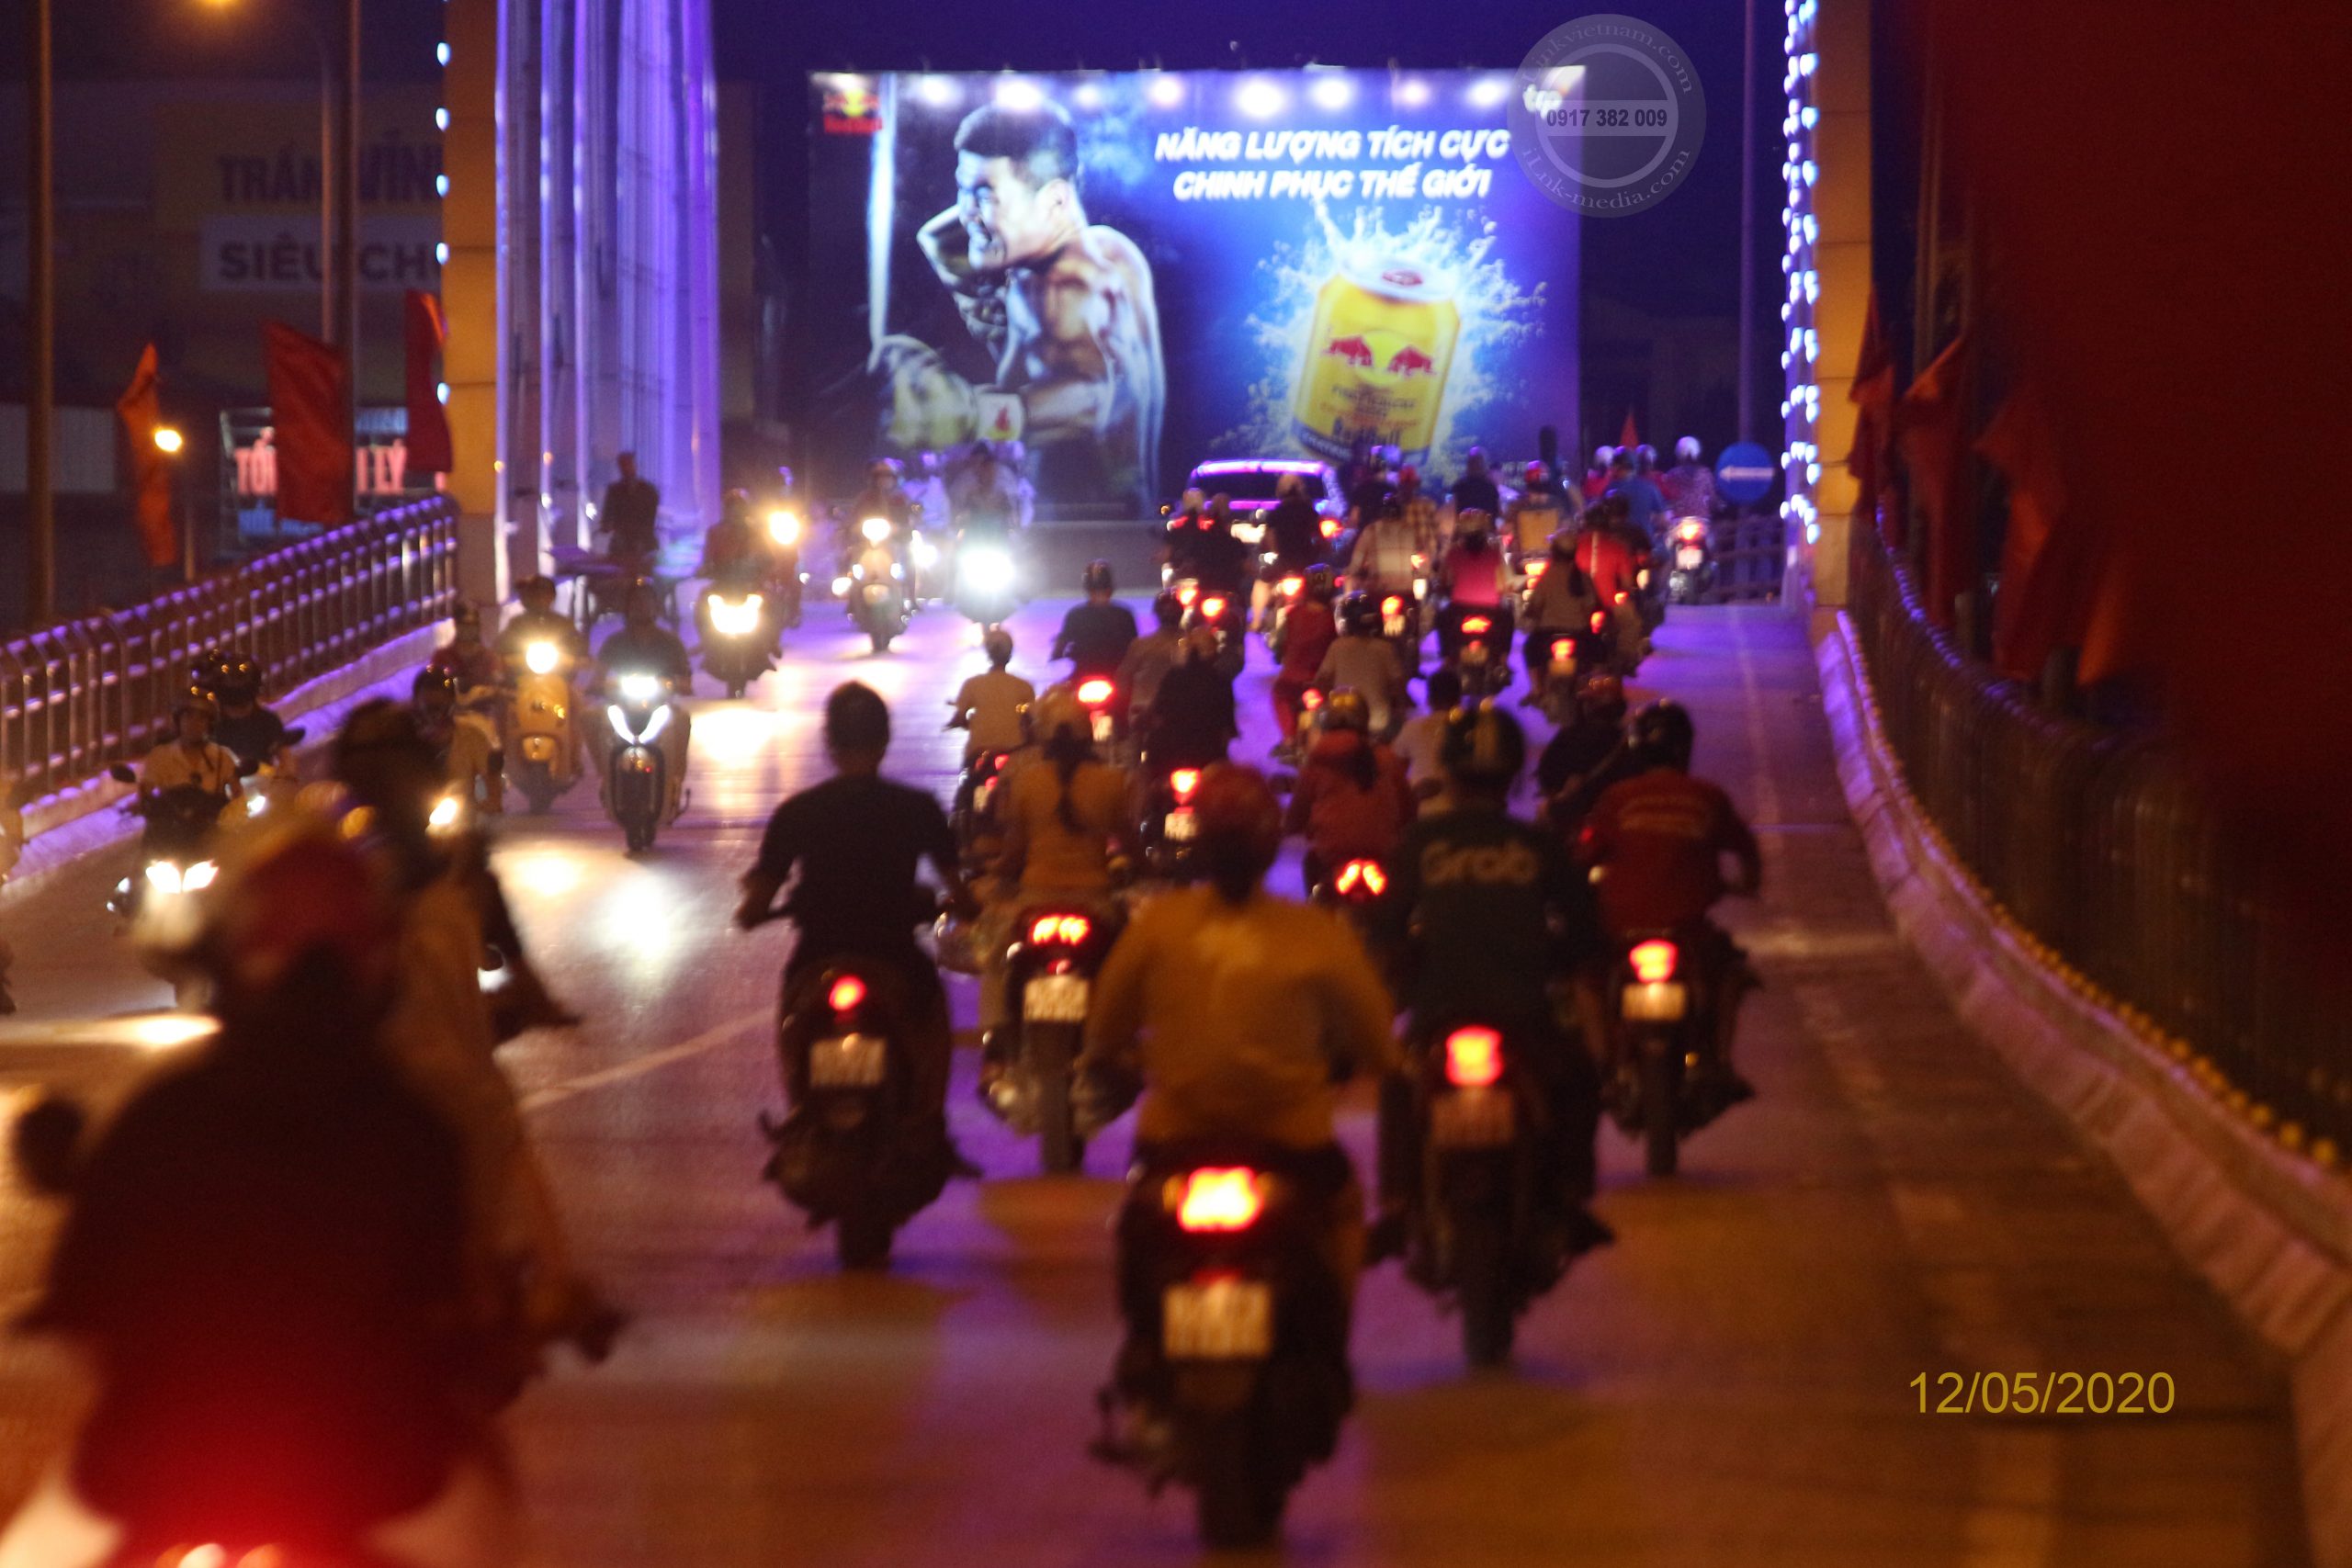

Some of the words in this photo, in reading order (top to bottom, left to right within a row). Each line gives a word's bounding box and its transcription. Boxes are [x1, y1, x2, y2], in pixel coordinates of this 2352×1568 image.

[1154, 127, 1241, 162] NĂNG
[1244, 130, 1362, 164] LƯỢNG
[1367, 125, 1436, 159] TÍCH
[1439, 129, 1511, 164] CỰC
[1172, 170, 1267, 200] CHINH
[1269, 169, 1353, 202] PHỤC
[1359, 162, 1423, 199] THẾ
[1421, 163, 1492, 199] GIỚI
[359, 242, 441, 282] CH
[1421, 839, 1539, 886] Grab
